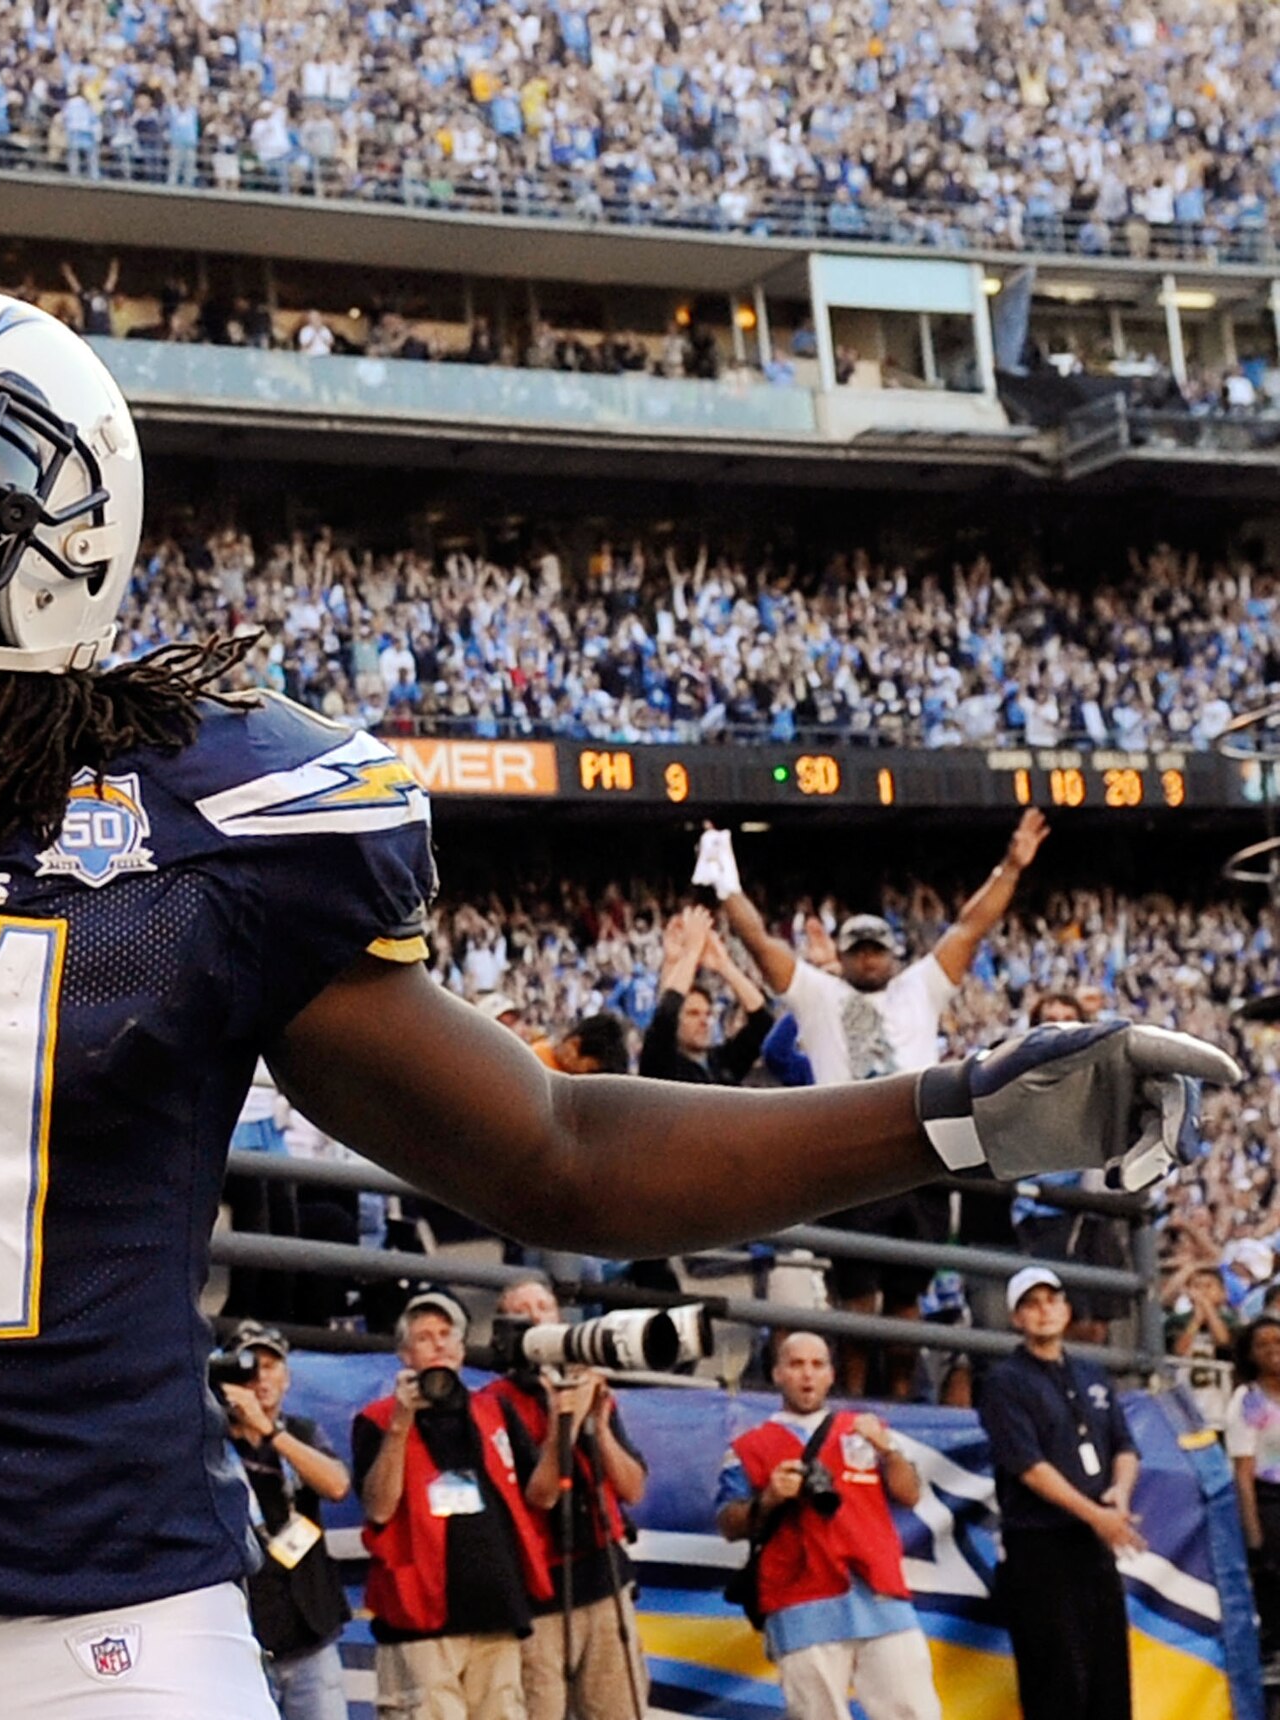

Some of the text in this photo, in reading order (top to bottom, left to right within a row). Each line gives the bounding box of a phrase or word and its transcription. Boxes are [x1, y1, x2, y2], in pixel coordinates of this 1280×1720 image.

[392, 742, 537, 790] MER
[579, 750, 634, 790] PHI
[1050, 768, 1086, 807] 10
[61, 810, 124, 848] 50
